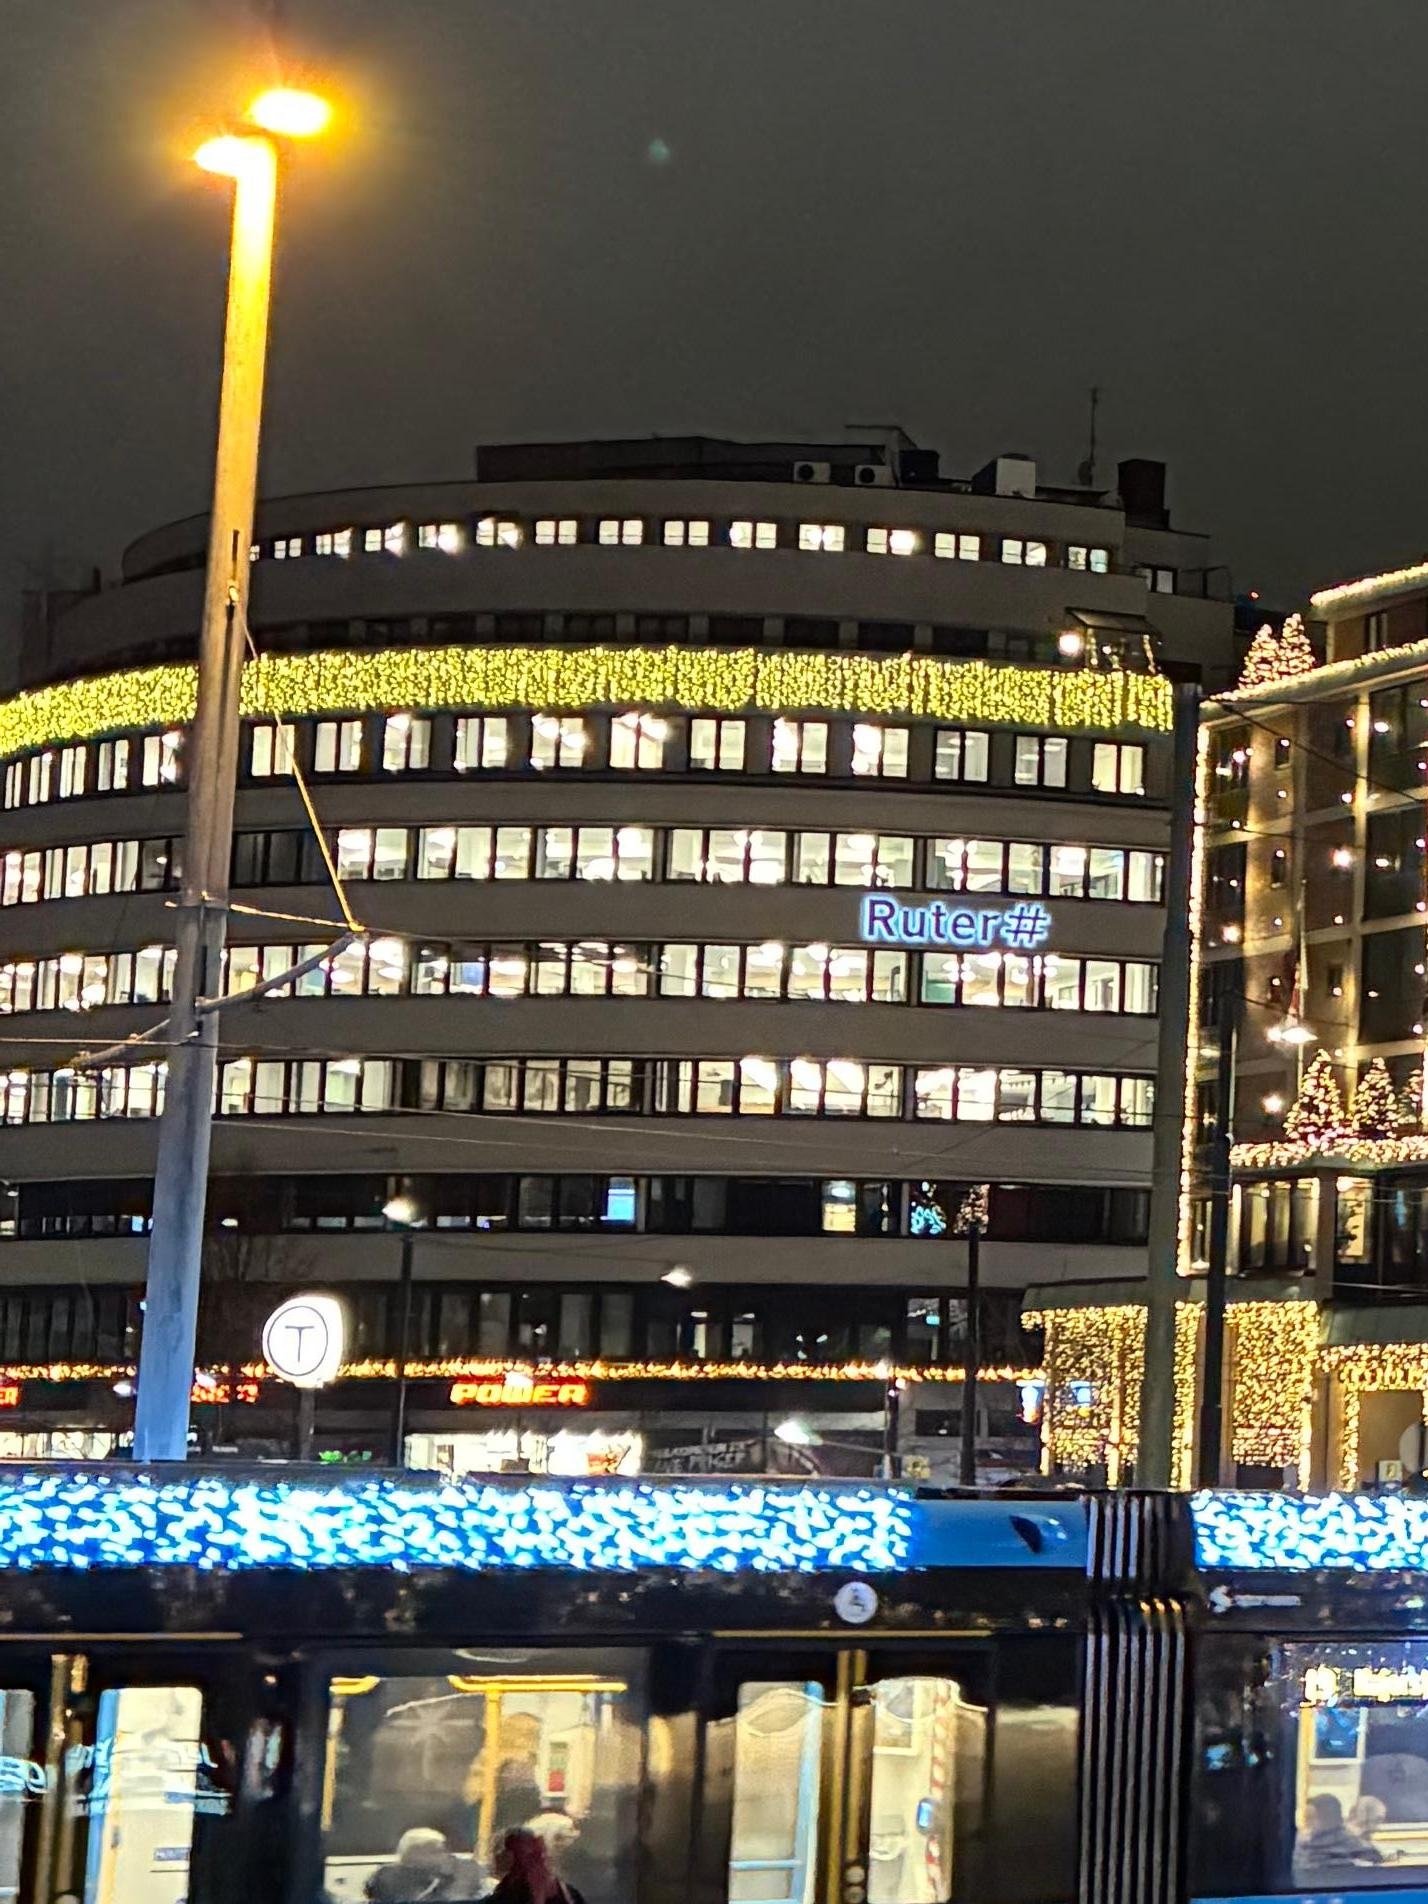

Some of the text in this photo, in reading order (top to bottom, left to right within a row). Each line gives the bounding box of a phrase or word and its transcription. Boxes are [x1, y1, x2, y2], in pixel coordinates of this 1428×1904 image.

[864, 896, 1050, 946] Ruter#
[284, 1324, 315, 1364] T
[450, 1382, 588, 1405] POWER
